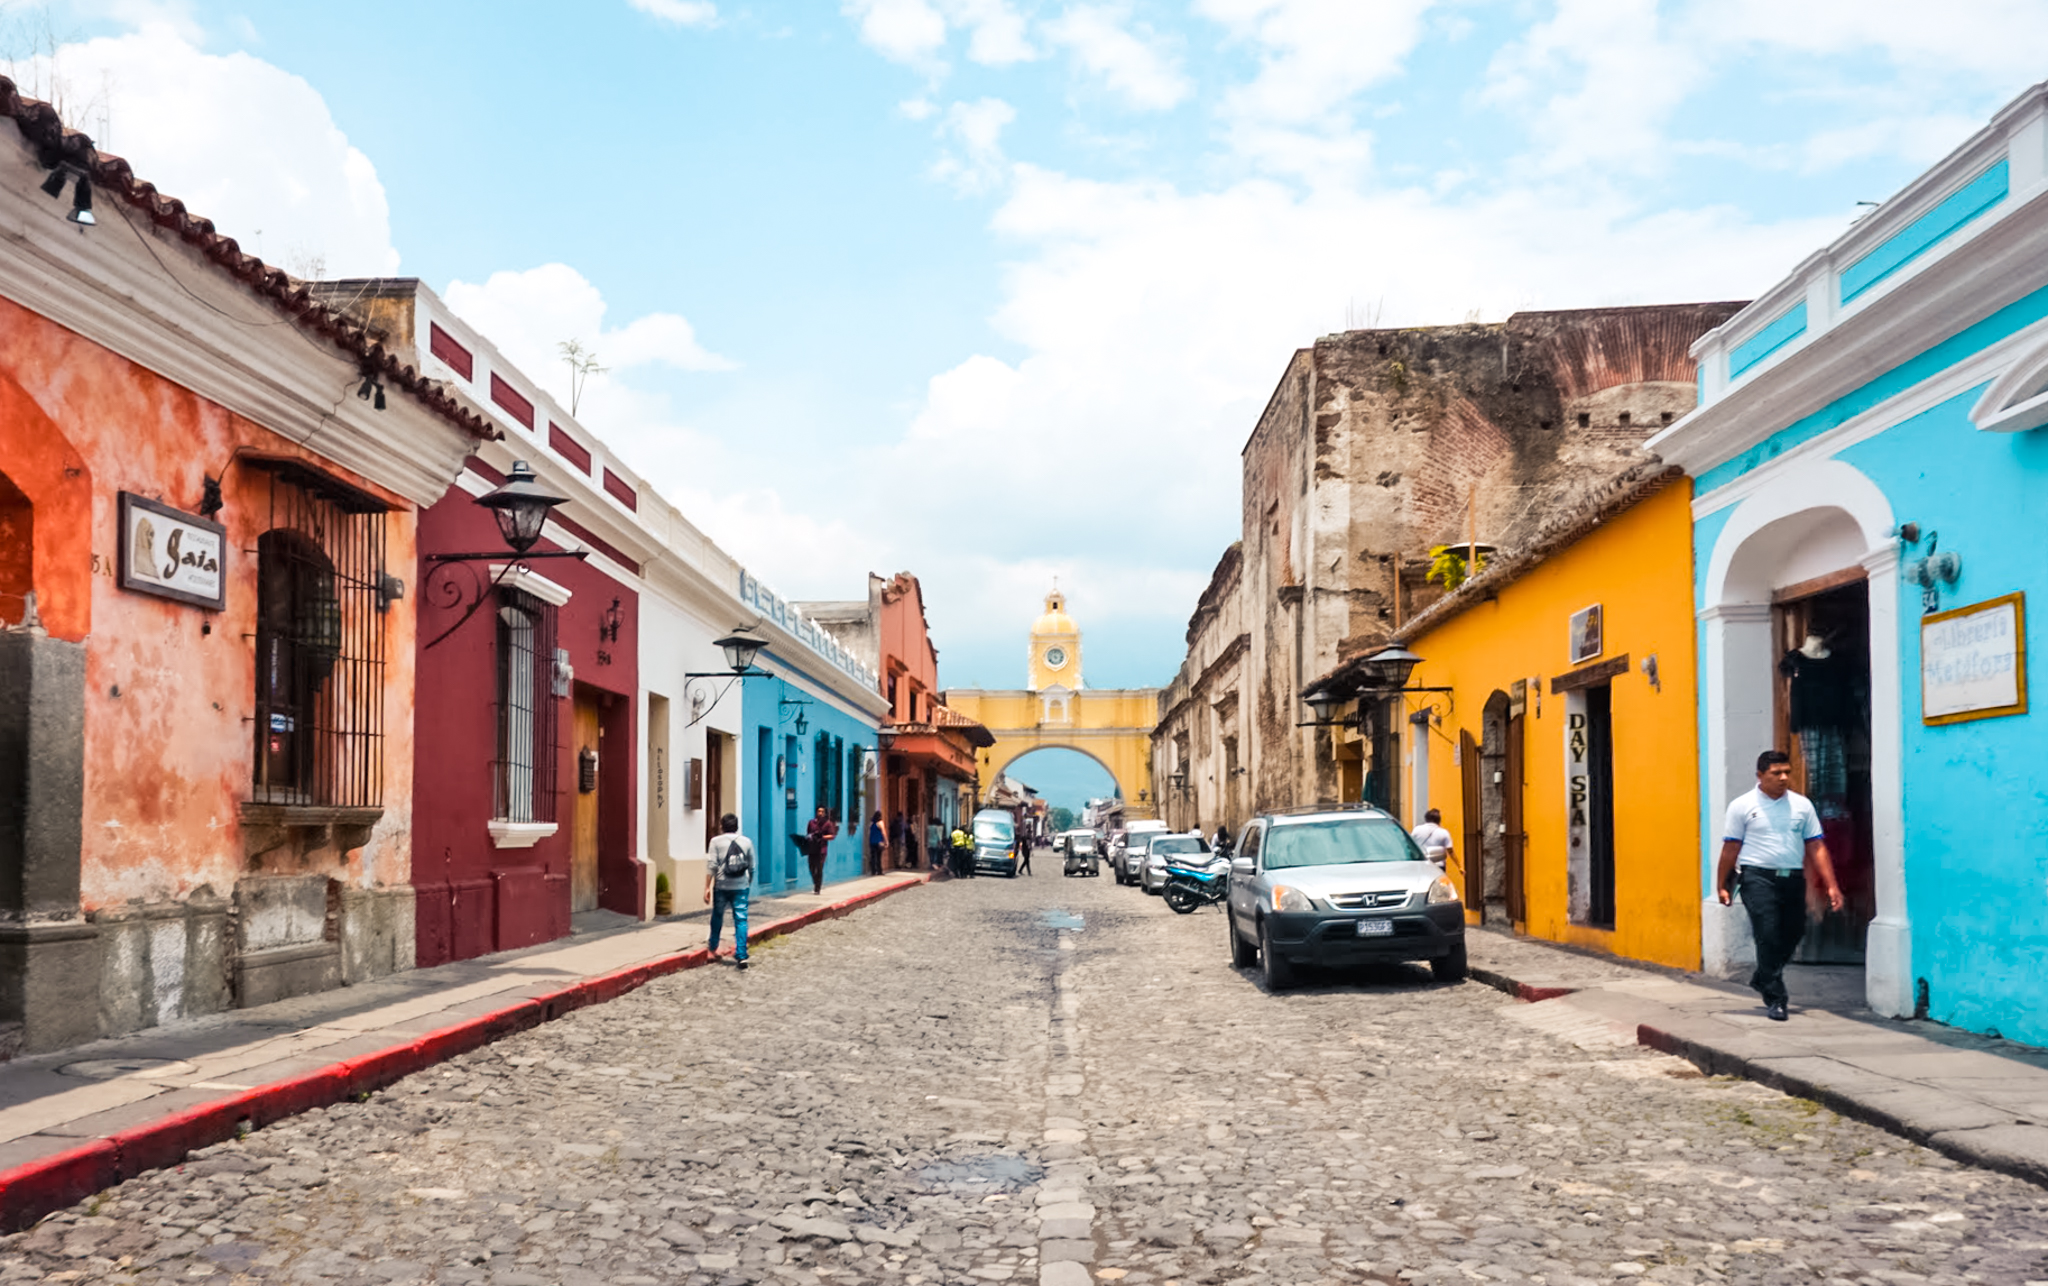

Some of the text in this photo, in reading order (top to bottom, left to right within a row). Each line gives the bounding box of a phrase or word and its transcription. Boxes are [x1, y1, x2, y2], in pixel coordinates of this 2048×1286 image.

[163, 528, 218, 579] Gaia
[1569, 713, 1587, 827] DAY SPA
